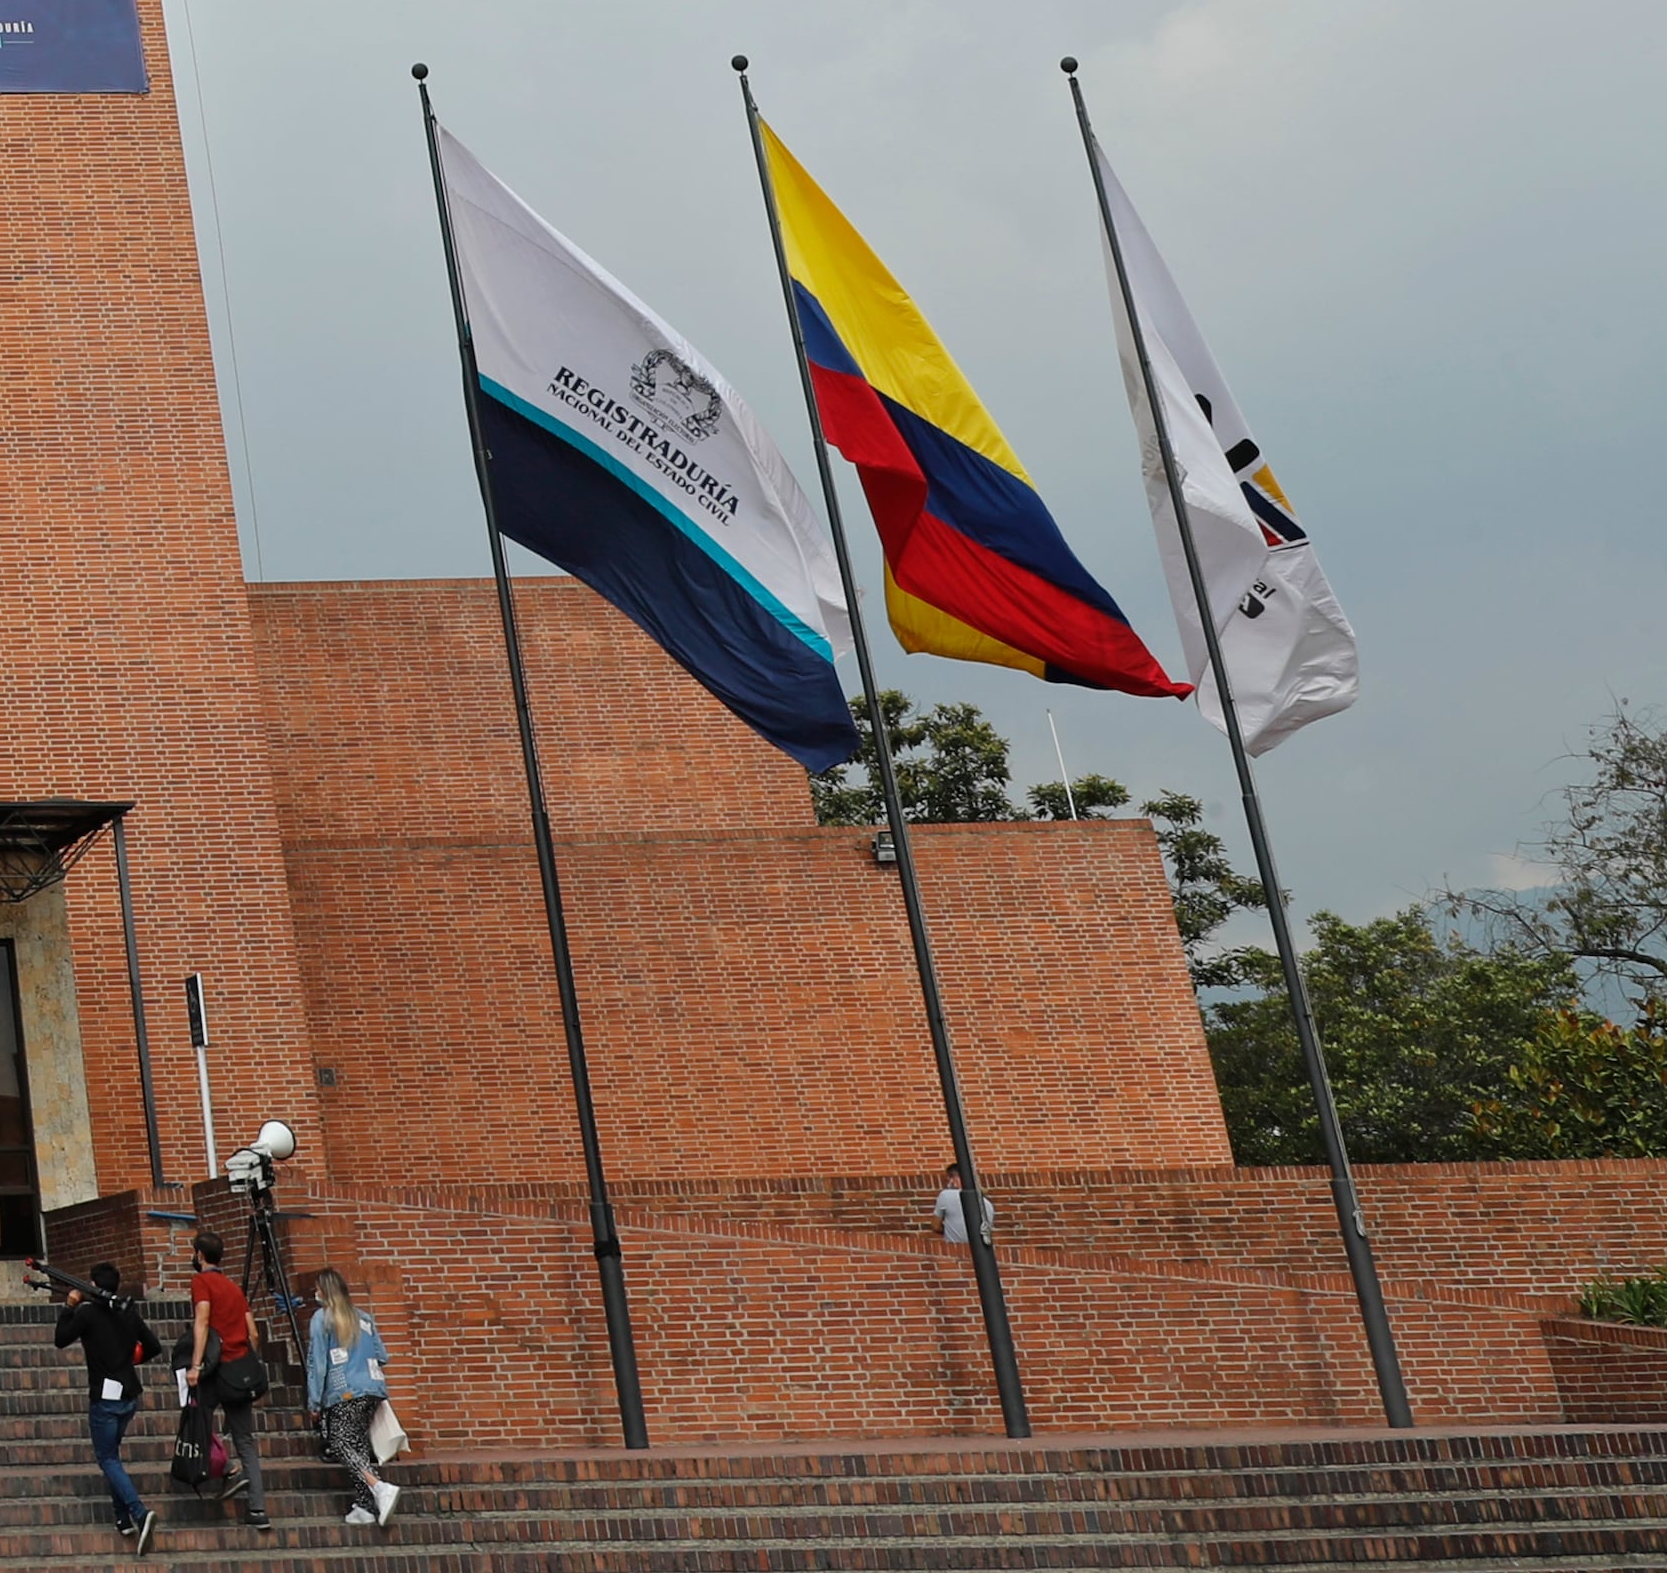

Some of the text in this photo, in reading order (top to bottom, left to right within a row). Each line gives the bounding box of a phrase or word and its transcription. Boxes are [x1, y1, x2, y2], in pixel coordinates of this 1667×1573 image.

[547, 383, 730, 527] NACIONAL DEL ESTADO CIVIL
[552, 366, 739, 517] REGISTRADURÍA
